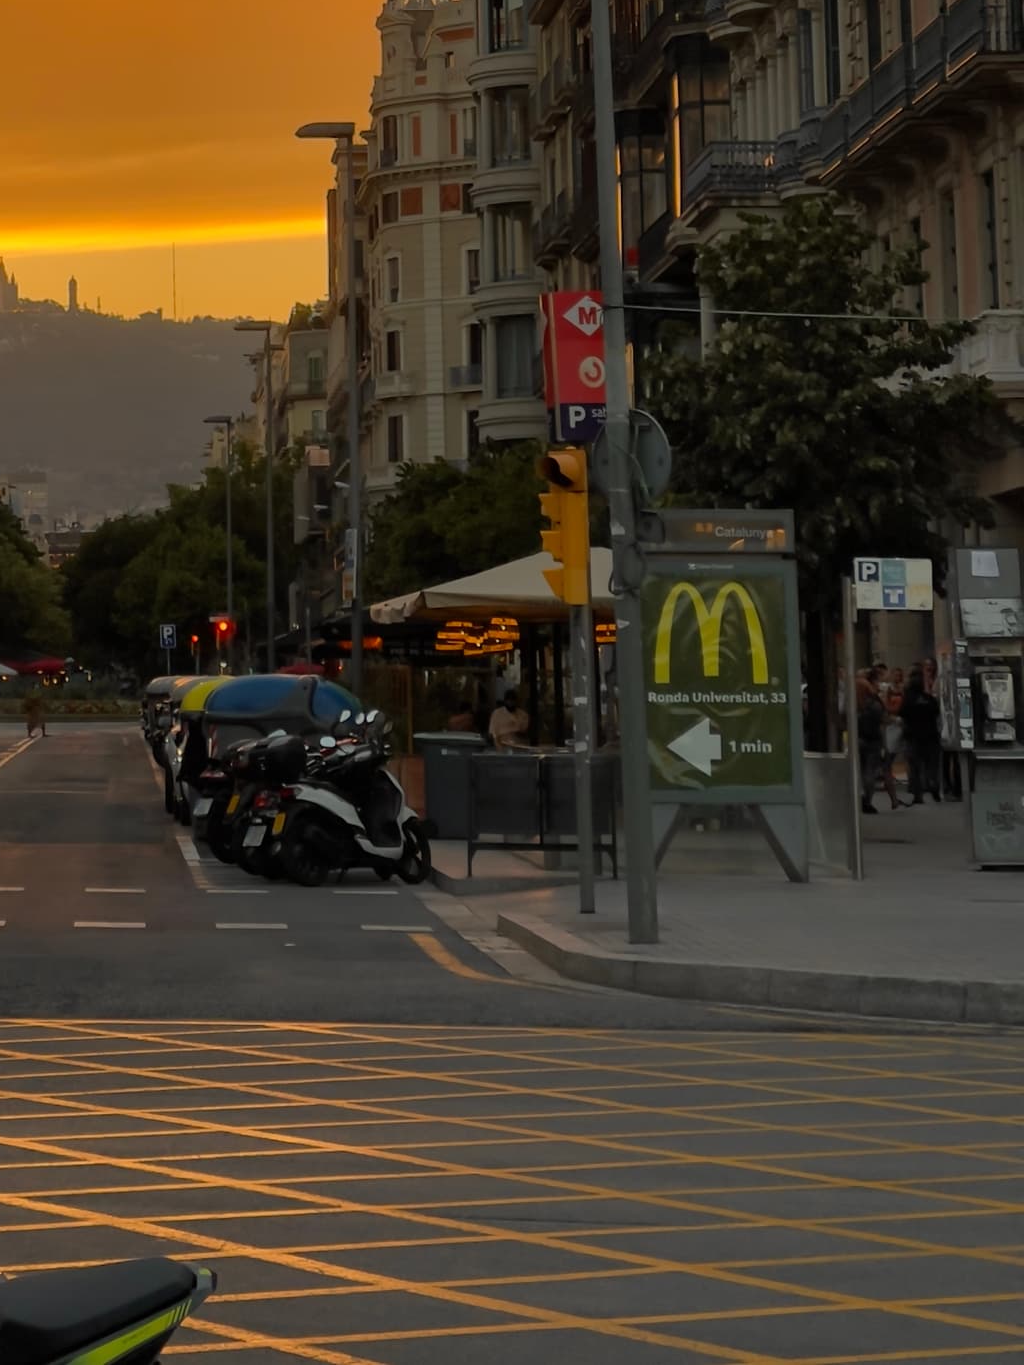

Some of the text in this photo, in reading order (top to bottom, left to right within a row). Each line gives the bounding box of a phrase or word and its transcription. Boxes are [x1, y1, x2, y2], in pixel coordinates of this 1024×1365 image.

[578, 307, 597, 325] M
[568, 405, 587, 429] P
[861, 562, 877, 581] P
[647, 691, 787, 705] Ronda Universitat, 33
[728, 739, 773, 753] 1 min
